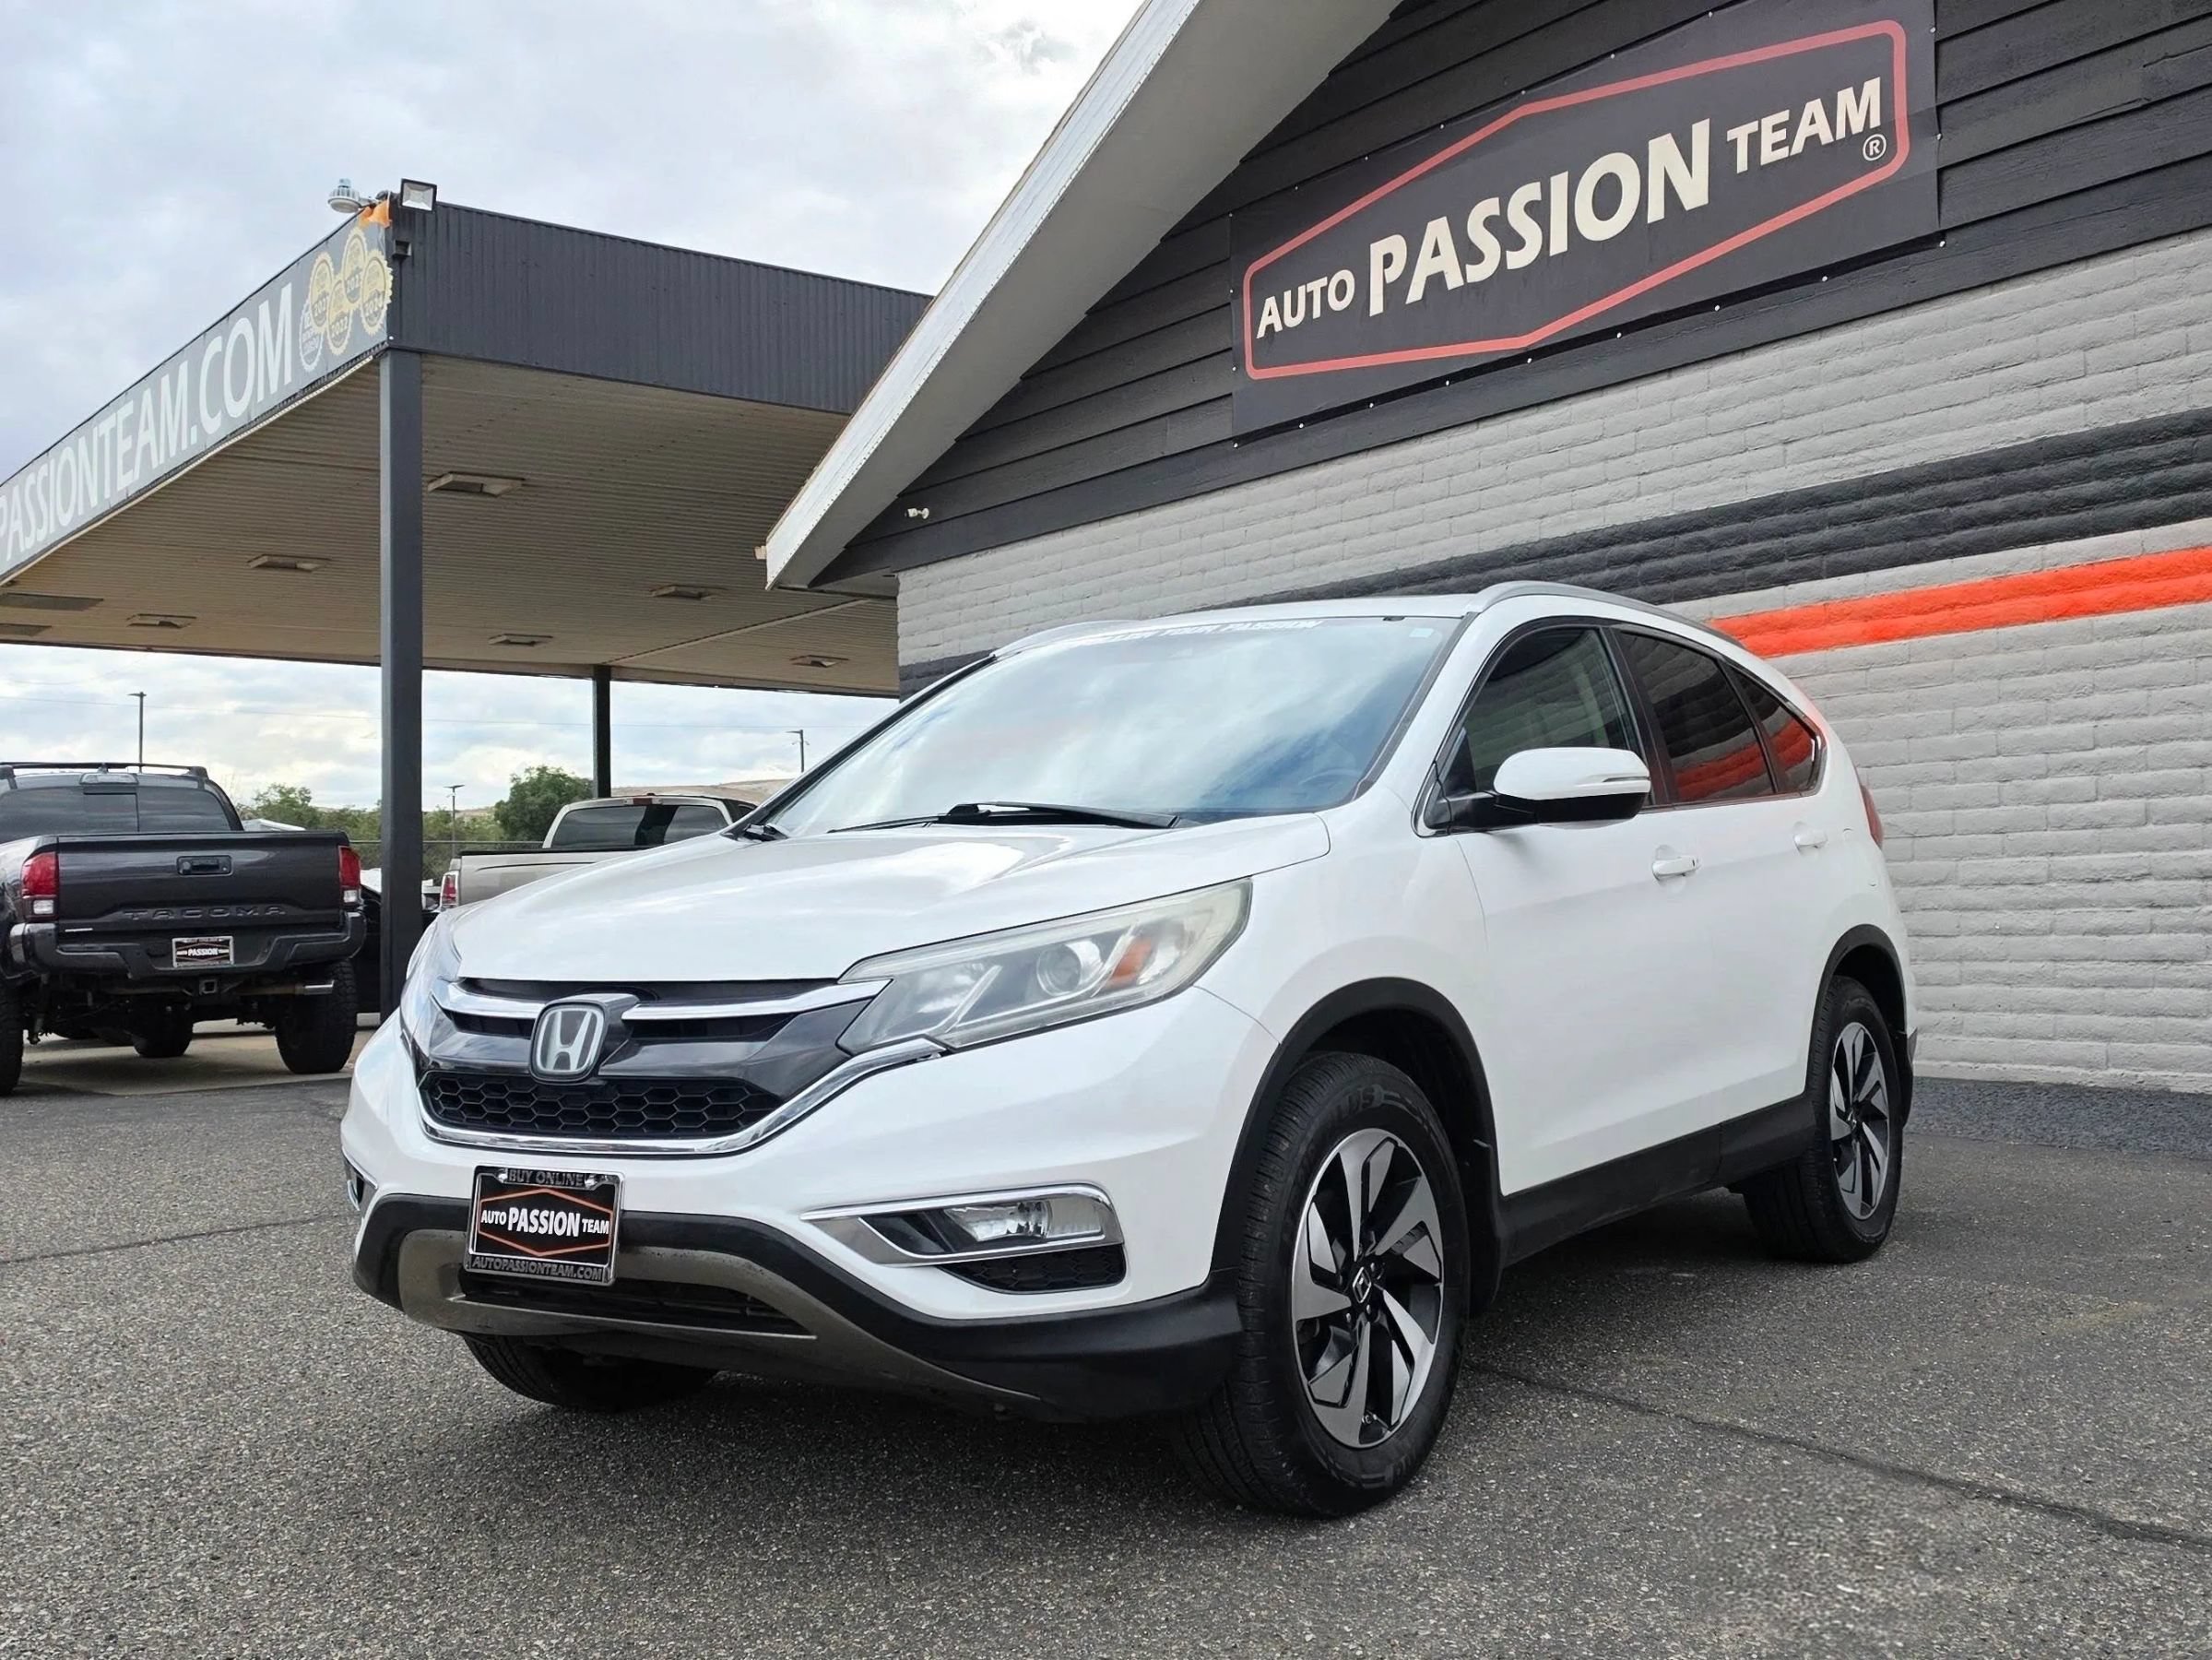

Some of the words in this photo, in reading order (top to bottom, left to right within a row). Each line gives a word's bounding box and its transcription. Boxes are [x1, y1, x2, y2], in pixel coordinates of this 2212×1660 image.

[1255, 268, 1356, 339] AUTO
[1368, 117, 1711, 317] PASSION
[1726, 77, 1882, 175] TEAM
[124, 905, 286, 921] TACOMA
[187, 947, 219, 956] PASSION
[508, 1168, 533, 1184] BUY
[536, 1170, 584, 1187] ONLINE
[480, 1209, 507, 1226] AUTO
[507, 1206, 581, 1237] PASSION
[582, 1217, 609, 1235] TEAM
[472, 1256, 603, 1281] AUTOPASSIONTEAM.COM
